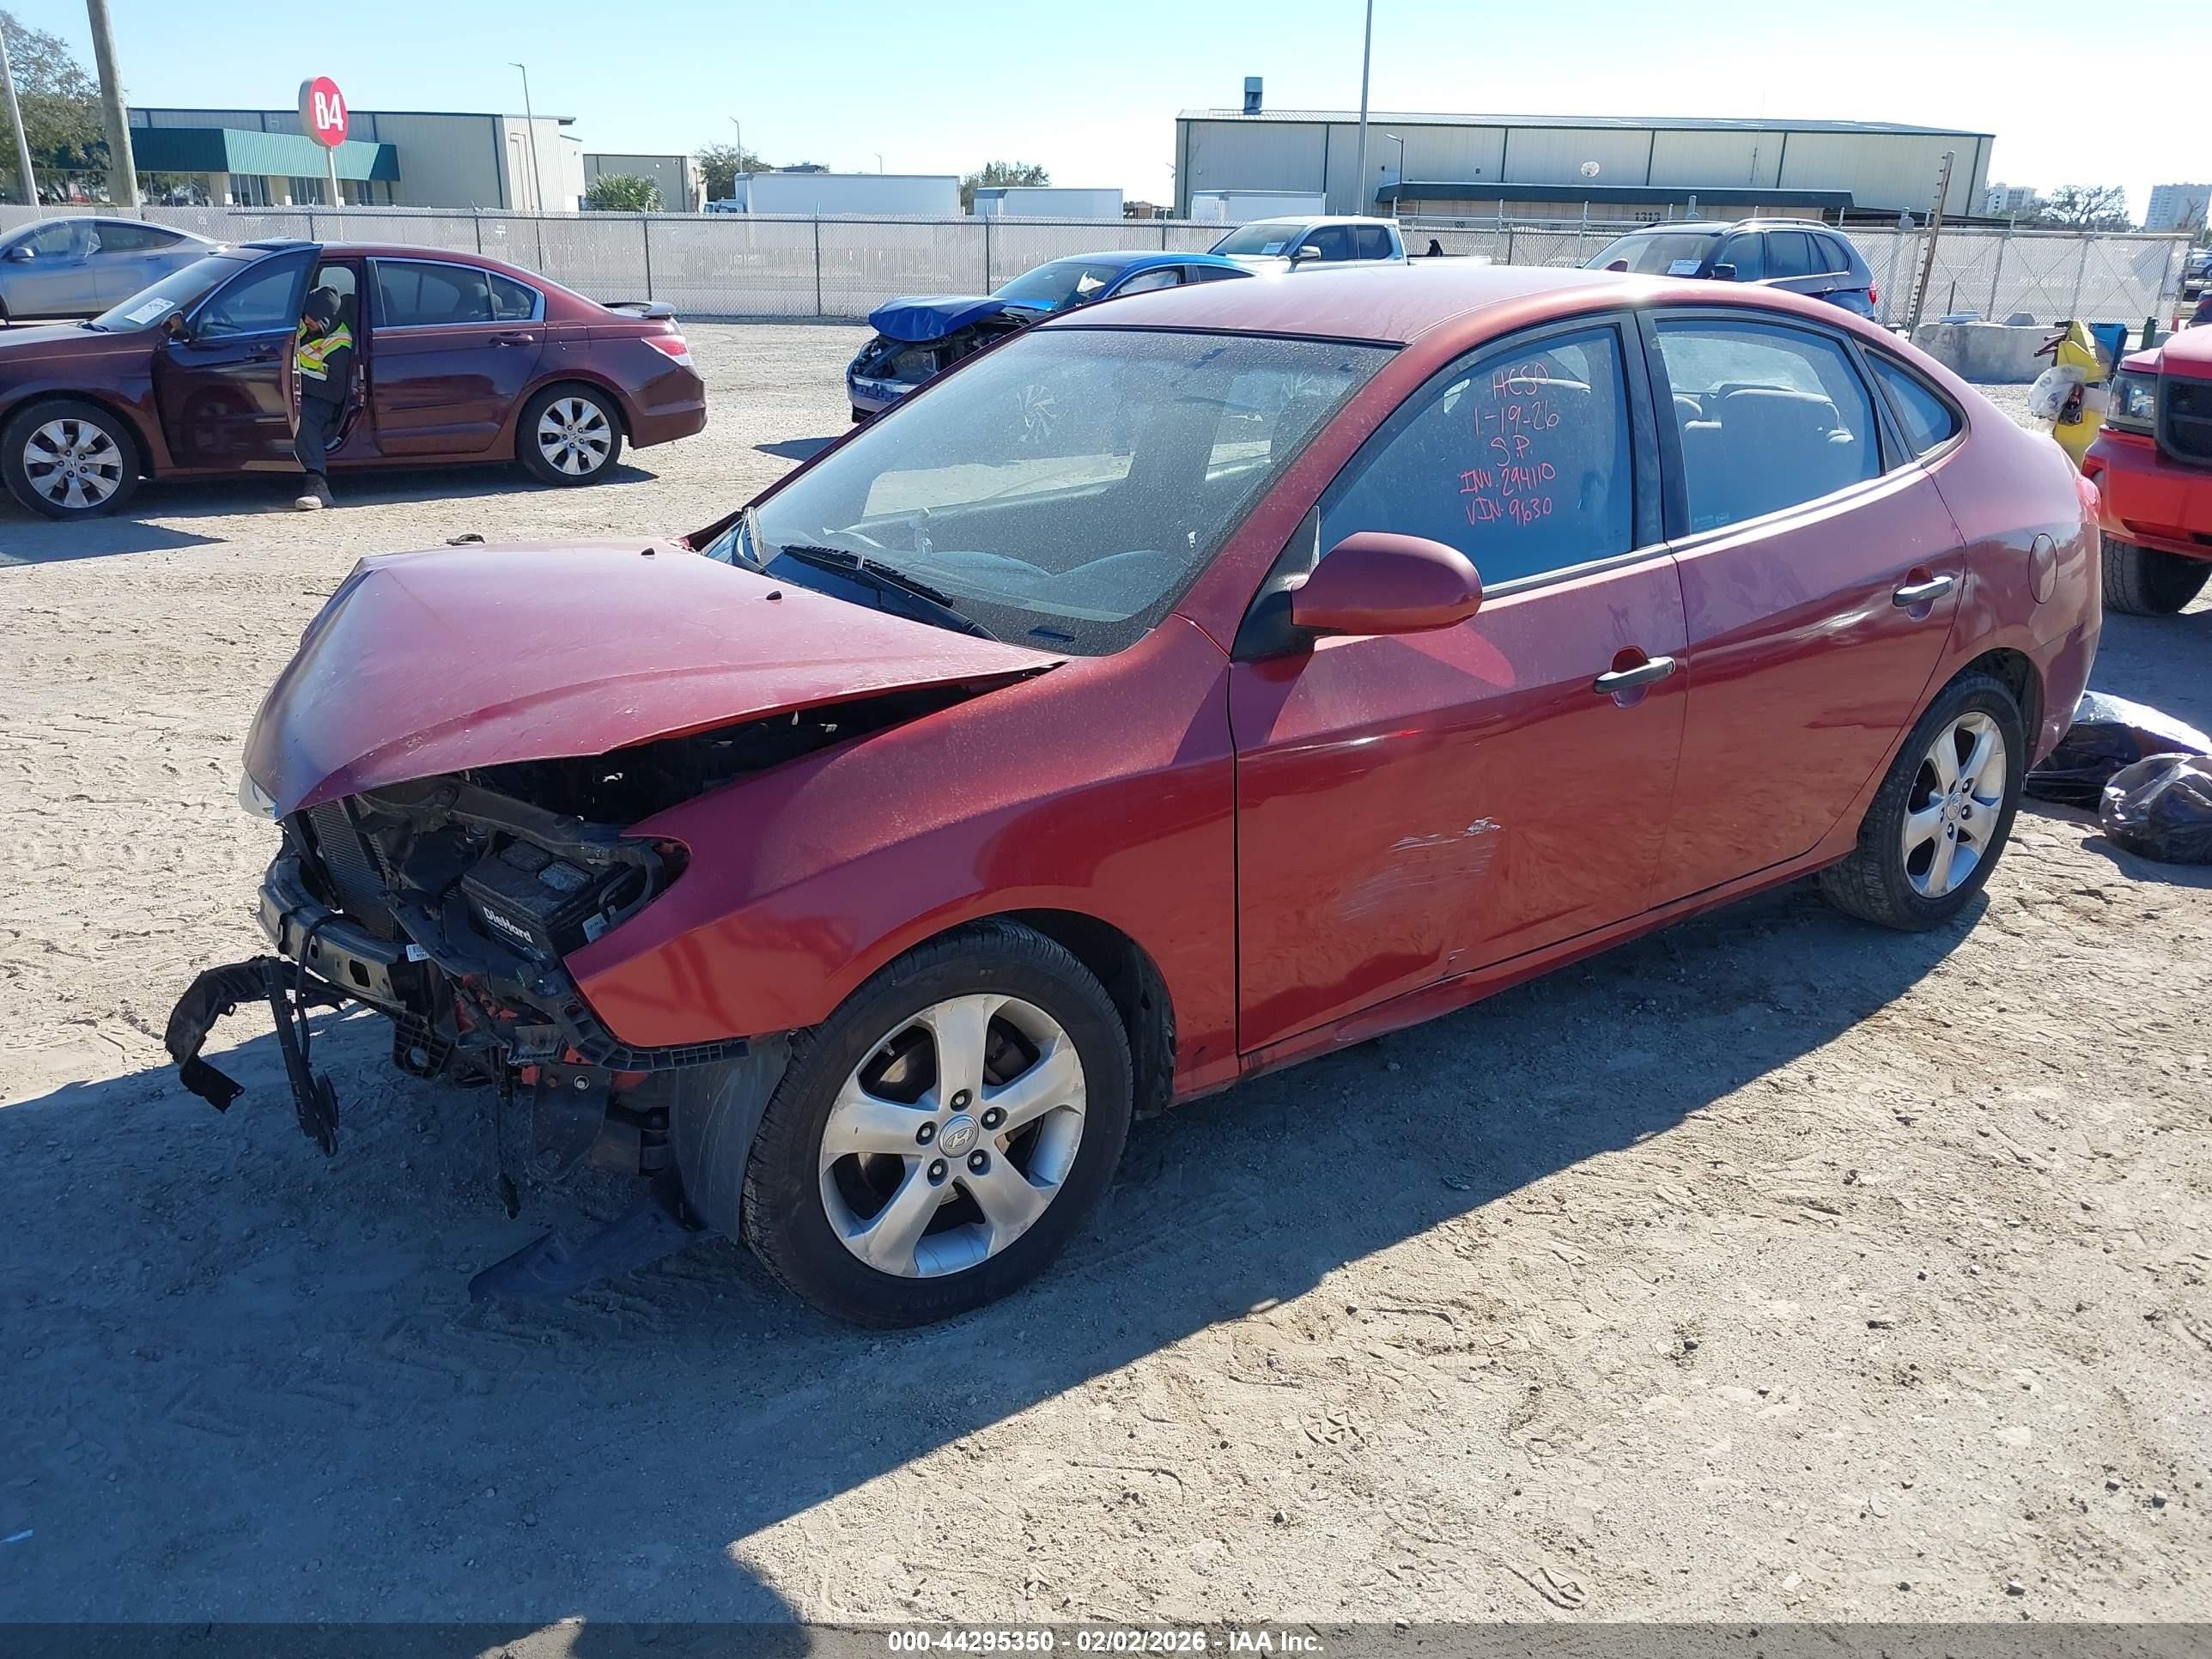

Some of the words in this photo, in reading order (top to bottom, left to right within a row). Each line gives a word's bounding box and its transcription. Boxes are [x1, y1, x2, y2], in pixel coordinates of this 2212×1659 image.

[313, 91, 344, 131] 84
[1492, 362, 1549, 400] HCSO
[1474, 400, 1559, 436] 1-19-26
[1502, 463, 1556, 496] 294110
[1509, 497, 1553, 526] 9630
[482, 906, 534, 944] DieHard
